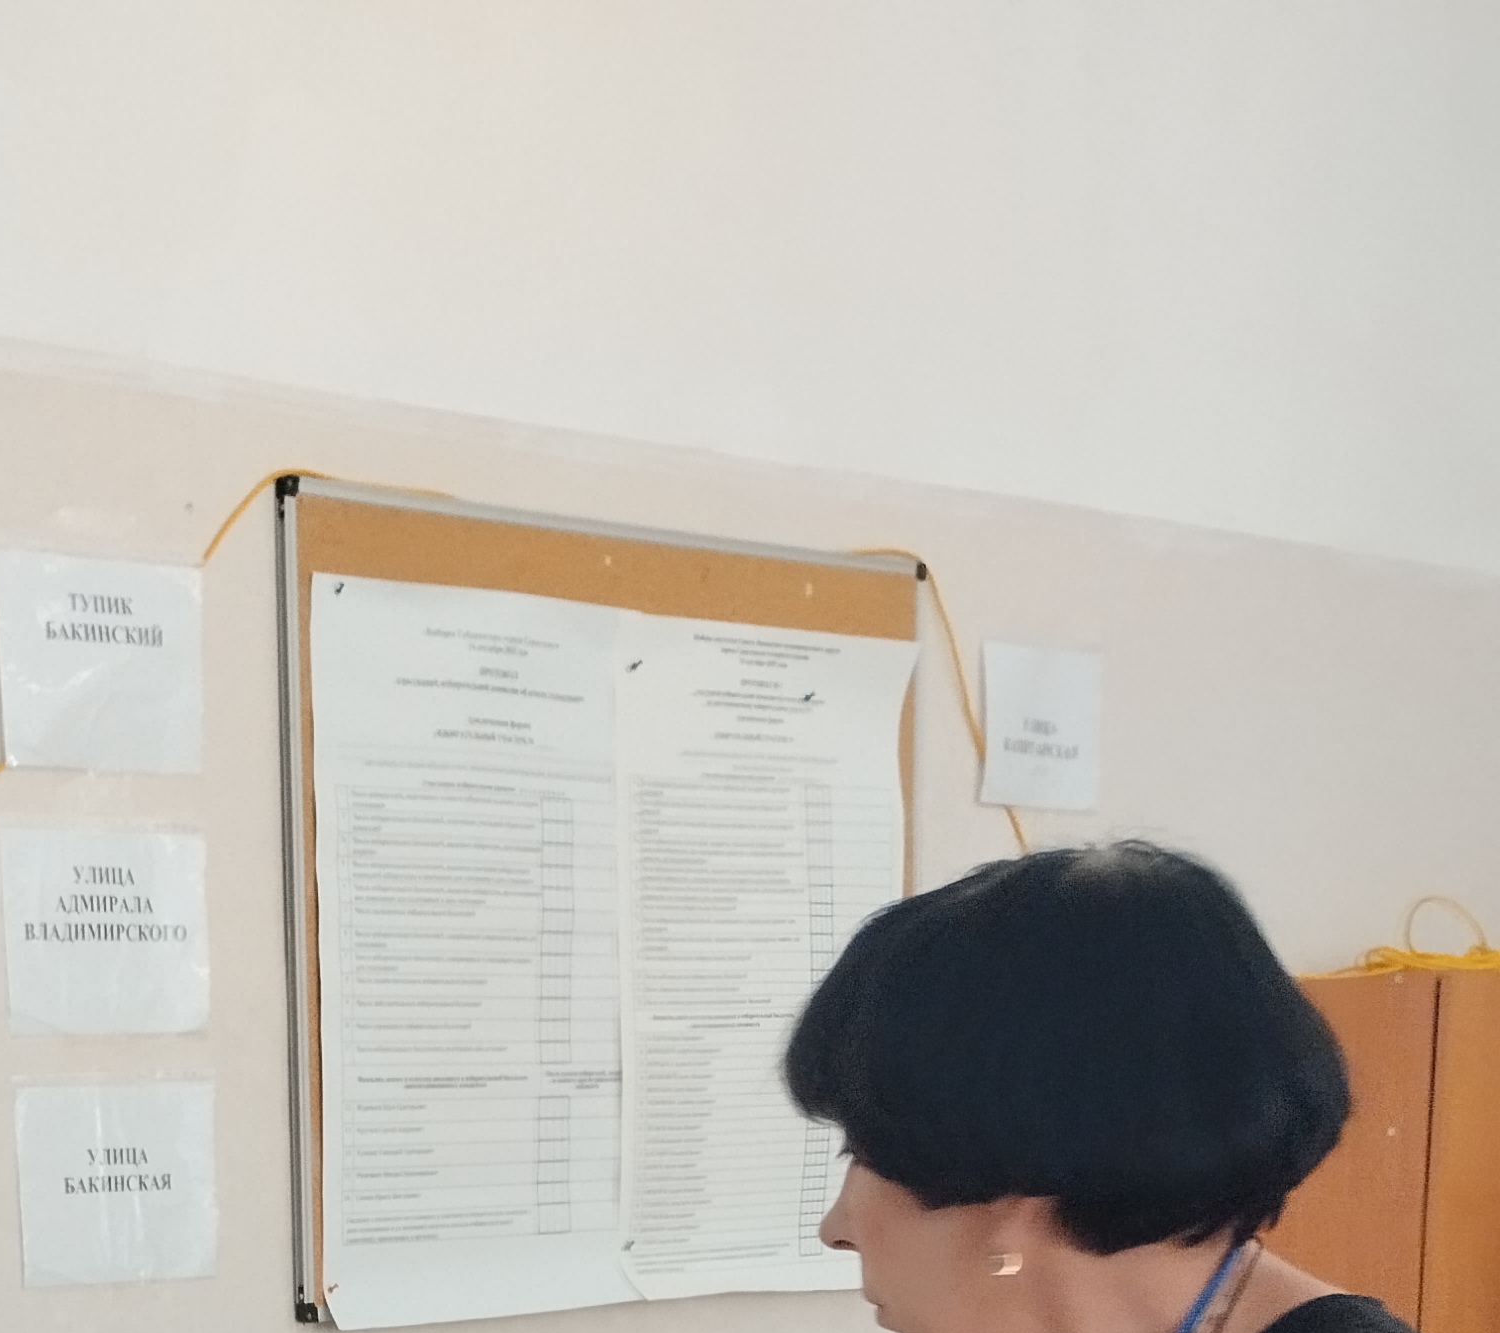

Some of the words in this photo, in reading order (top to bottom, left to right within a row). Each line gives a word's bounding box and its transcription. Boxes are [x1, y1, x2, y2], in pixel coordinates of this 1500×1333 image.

[69, 592, 132, 615] ТУПИК
[45, 621, 163, 647] БАКИНСКИЙ
[73, 866, 134, 886] УЛИЦА
[56, 893, 154, 915] АДМИРАЛА
[24, 922, 188, 943] ВЛАДИМИРСКОГО
[87, 1147, 148, 1167] УЛИЦА
[63, 1173, 172, 1195] БАКИНСКАЯ
